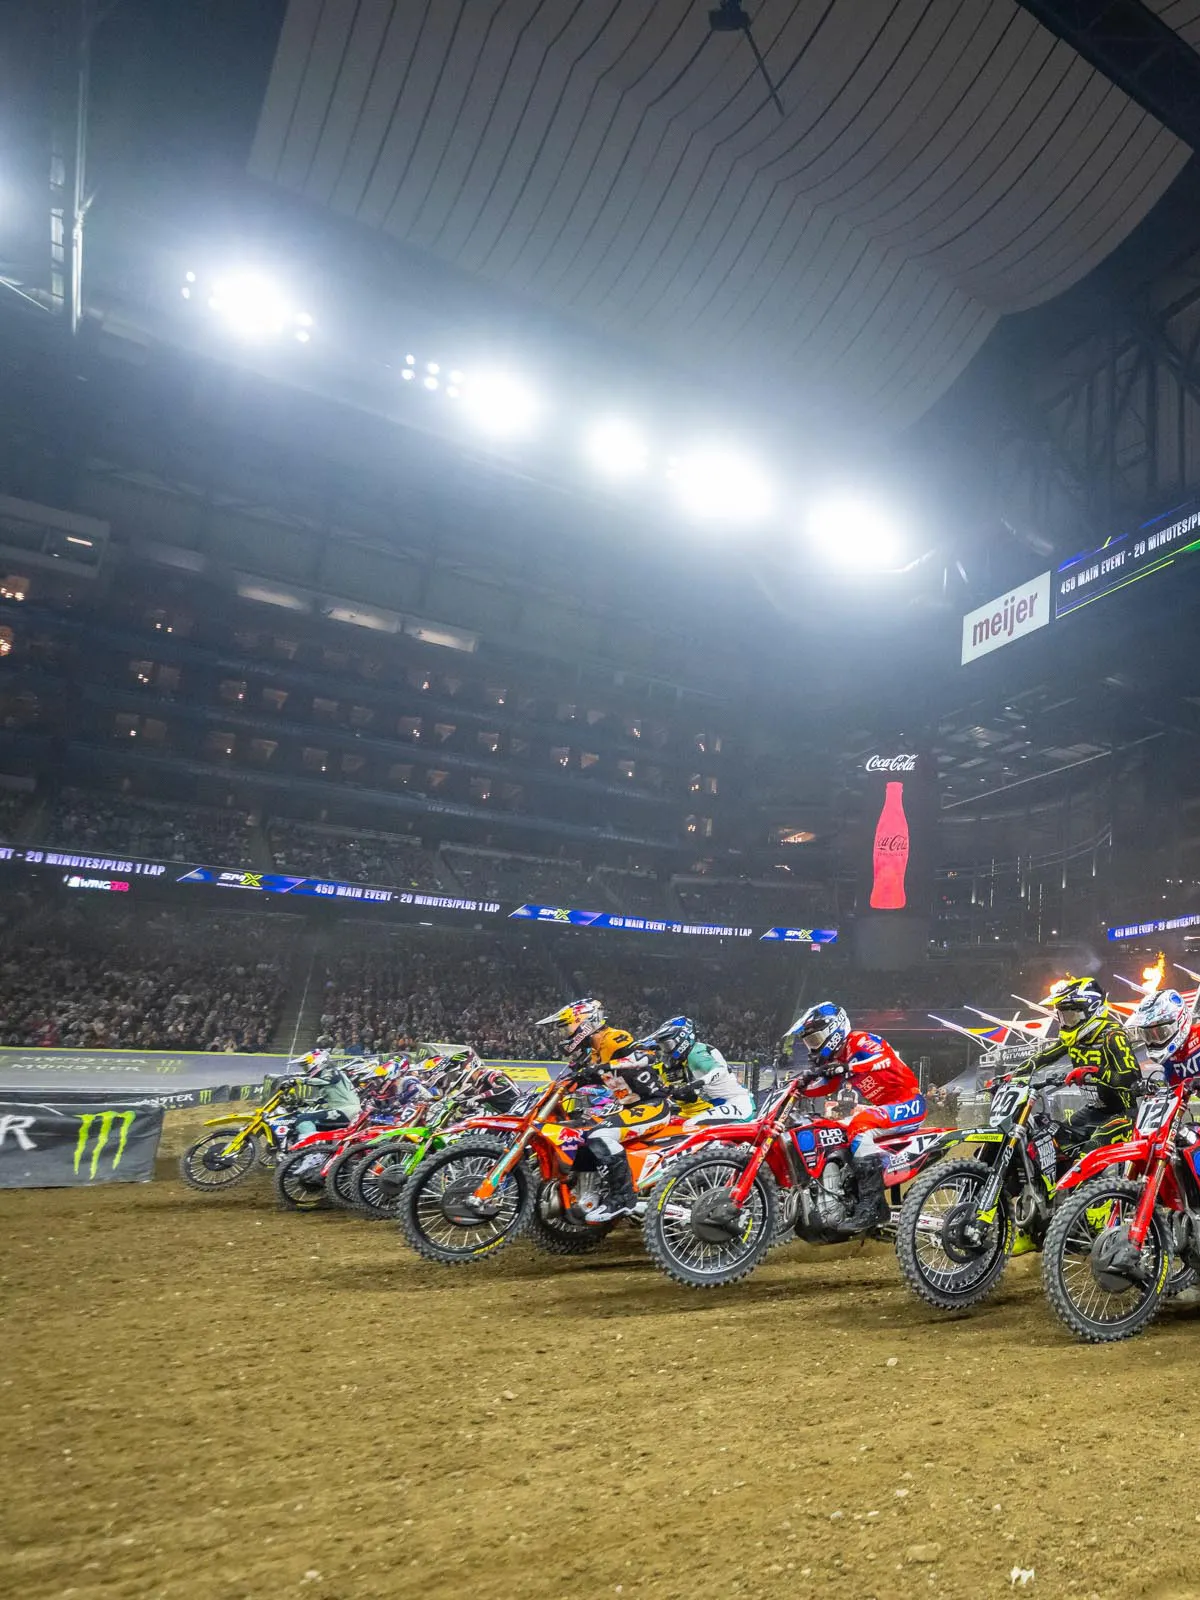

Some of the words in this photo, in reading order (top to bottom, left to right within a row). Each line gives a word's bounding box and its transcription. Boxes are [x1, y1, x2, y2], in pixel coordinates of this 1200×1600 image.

[1061, 576, 1076, 596] 450
[1077, 565, 1099, 587] MAIN
[1101, 550, 1126, 576] EVENT
[1134, 542, 1145, 559] 20
[972, 591, 1039, 647] meijer
[866, 754, 919, 772] Coca-Cola
[25, 850, 42, 863] 20
[46, 852, 134, 873] MINUTES/PLUS
[143, 863, 166, 876] LAP
[219, 872, 263, 888] SMX
[315, 883, 334, 896] 450
[336, 886, 362, 898] MAIN
[364, 889, 392, 902] EVENT
[400, 893, 413, 905] 20
[484, 902, 500, 913] LAP
[537, 908, 571, 921] SMX
[608, 916, 624, 928] 450
[625, 918, 644, 929] MAIN
[646, 919, 666, 931] EVENT
[672, 923, 682, 933] 20
[739, 927, 752, 937] LAP
[1137, 1102, 1169, 1130] 12
[819, 1128, 843, 1139] QUAD
[820, 1136, 846, 1148] LOCK
[916, 1133, 939, 1153] 17
